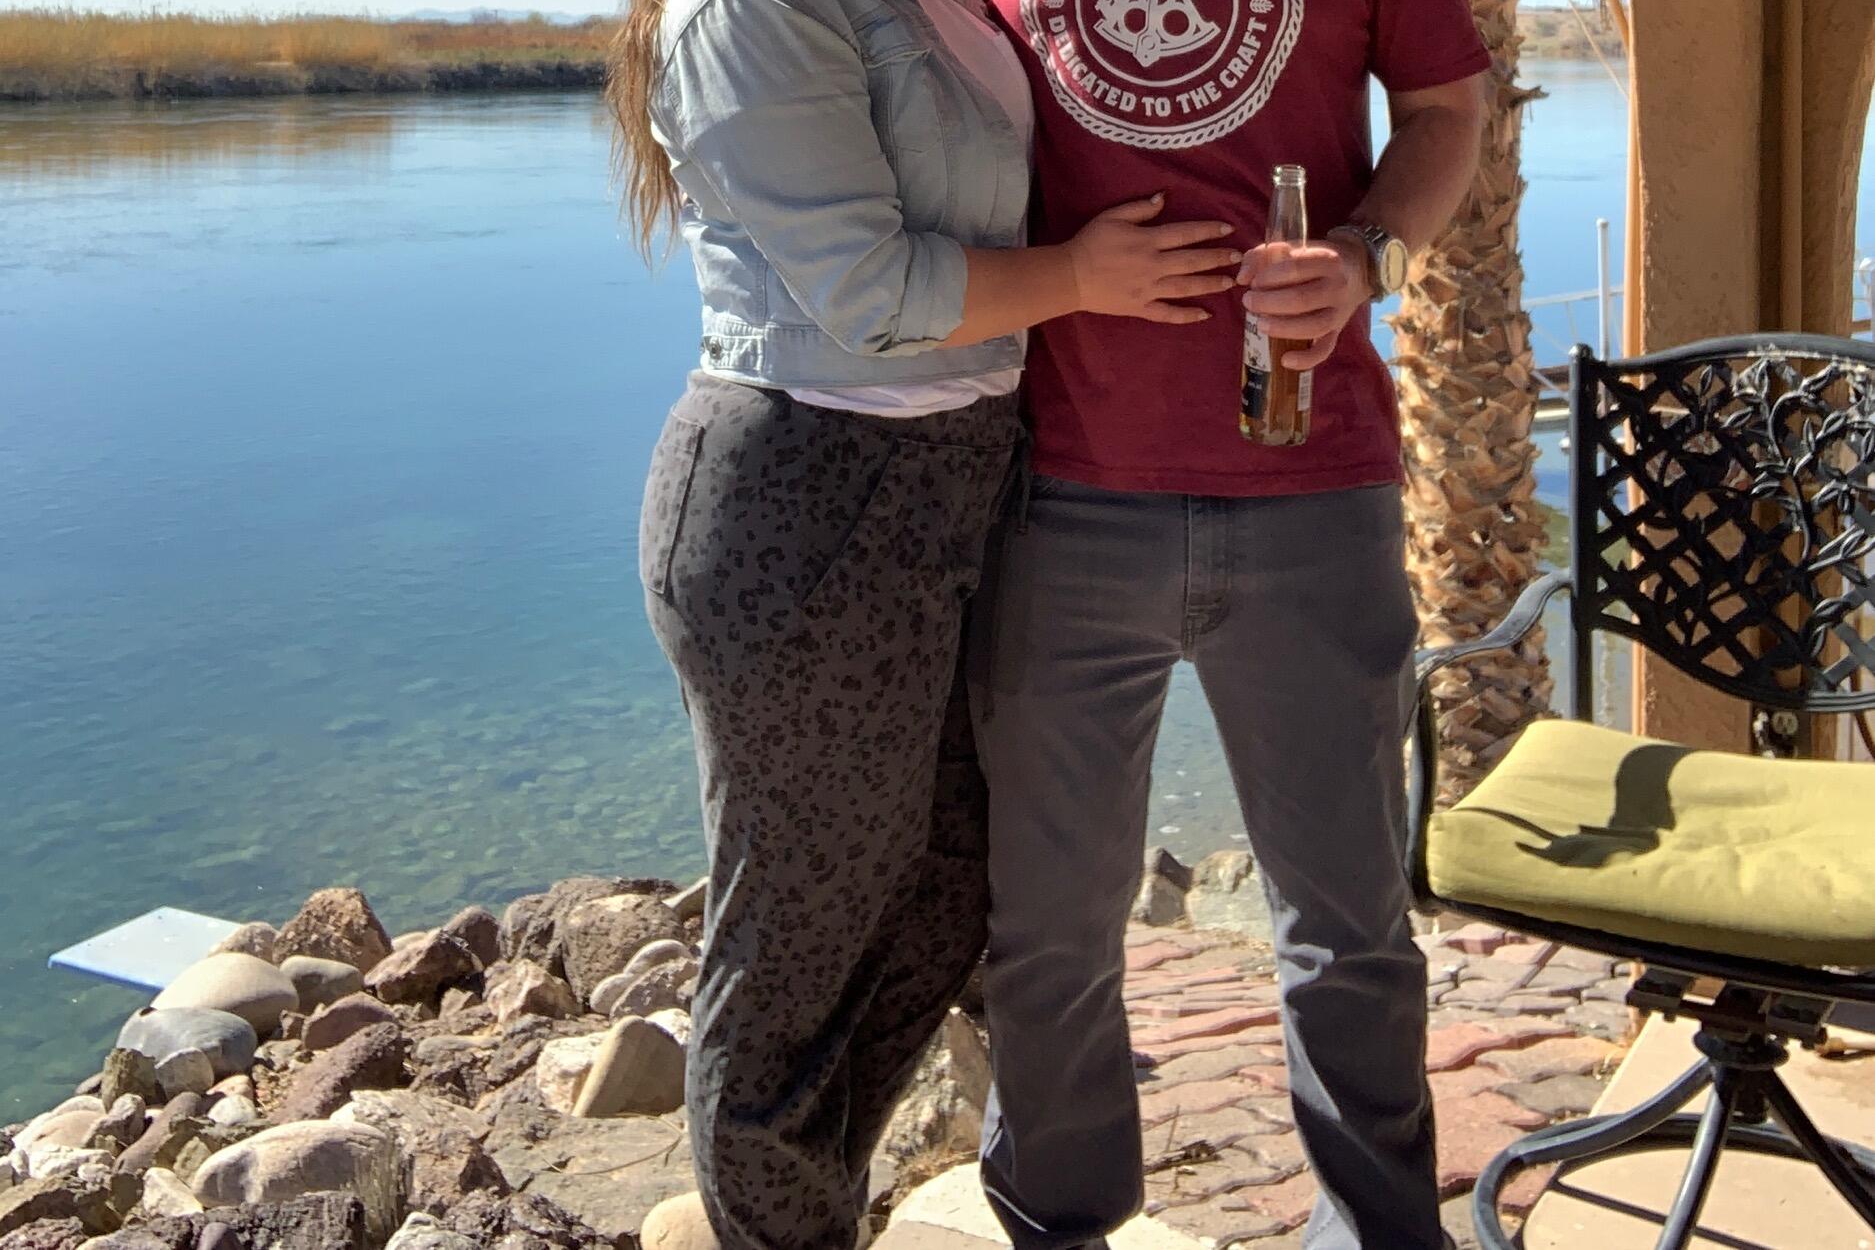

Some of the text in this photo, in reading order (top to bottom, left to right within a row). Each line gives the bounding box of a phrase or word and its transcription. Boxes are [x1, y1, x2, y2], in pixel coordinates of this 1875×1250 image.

[1048, 15, 1267, 117] DEDICATED TO THE CRAFT
